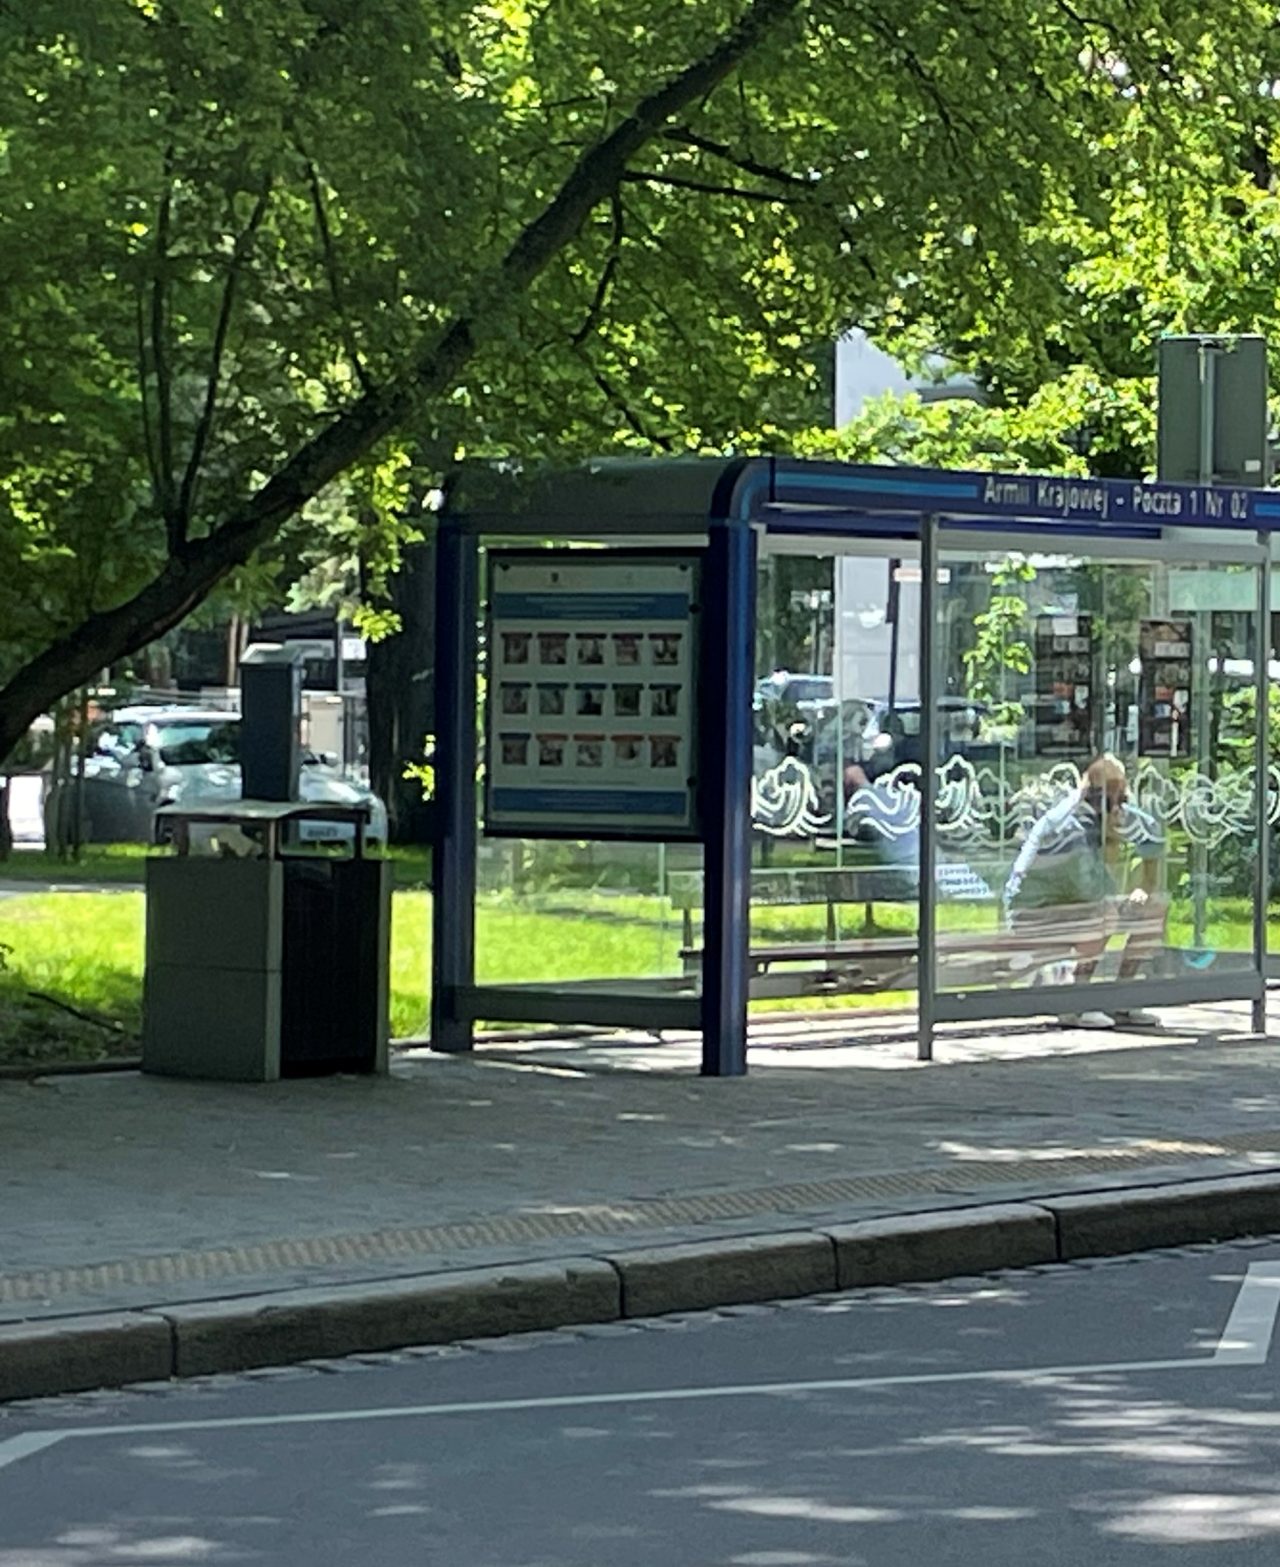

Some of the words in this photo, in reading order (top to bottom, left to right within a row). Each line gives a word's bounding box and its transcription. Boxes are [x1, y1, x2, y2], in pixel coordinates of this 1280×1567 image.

[984, 475, 1030, 505] Armii
[1037, 480, 1109, 519] Krajowej
[1132, 485, 1181, 515] Poczta
[1189, 490, 1198, 515] 1
[1205, 489, 1224, 518] Nr
[1230, 491, 1248, 519] 02
